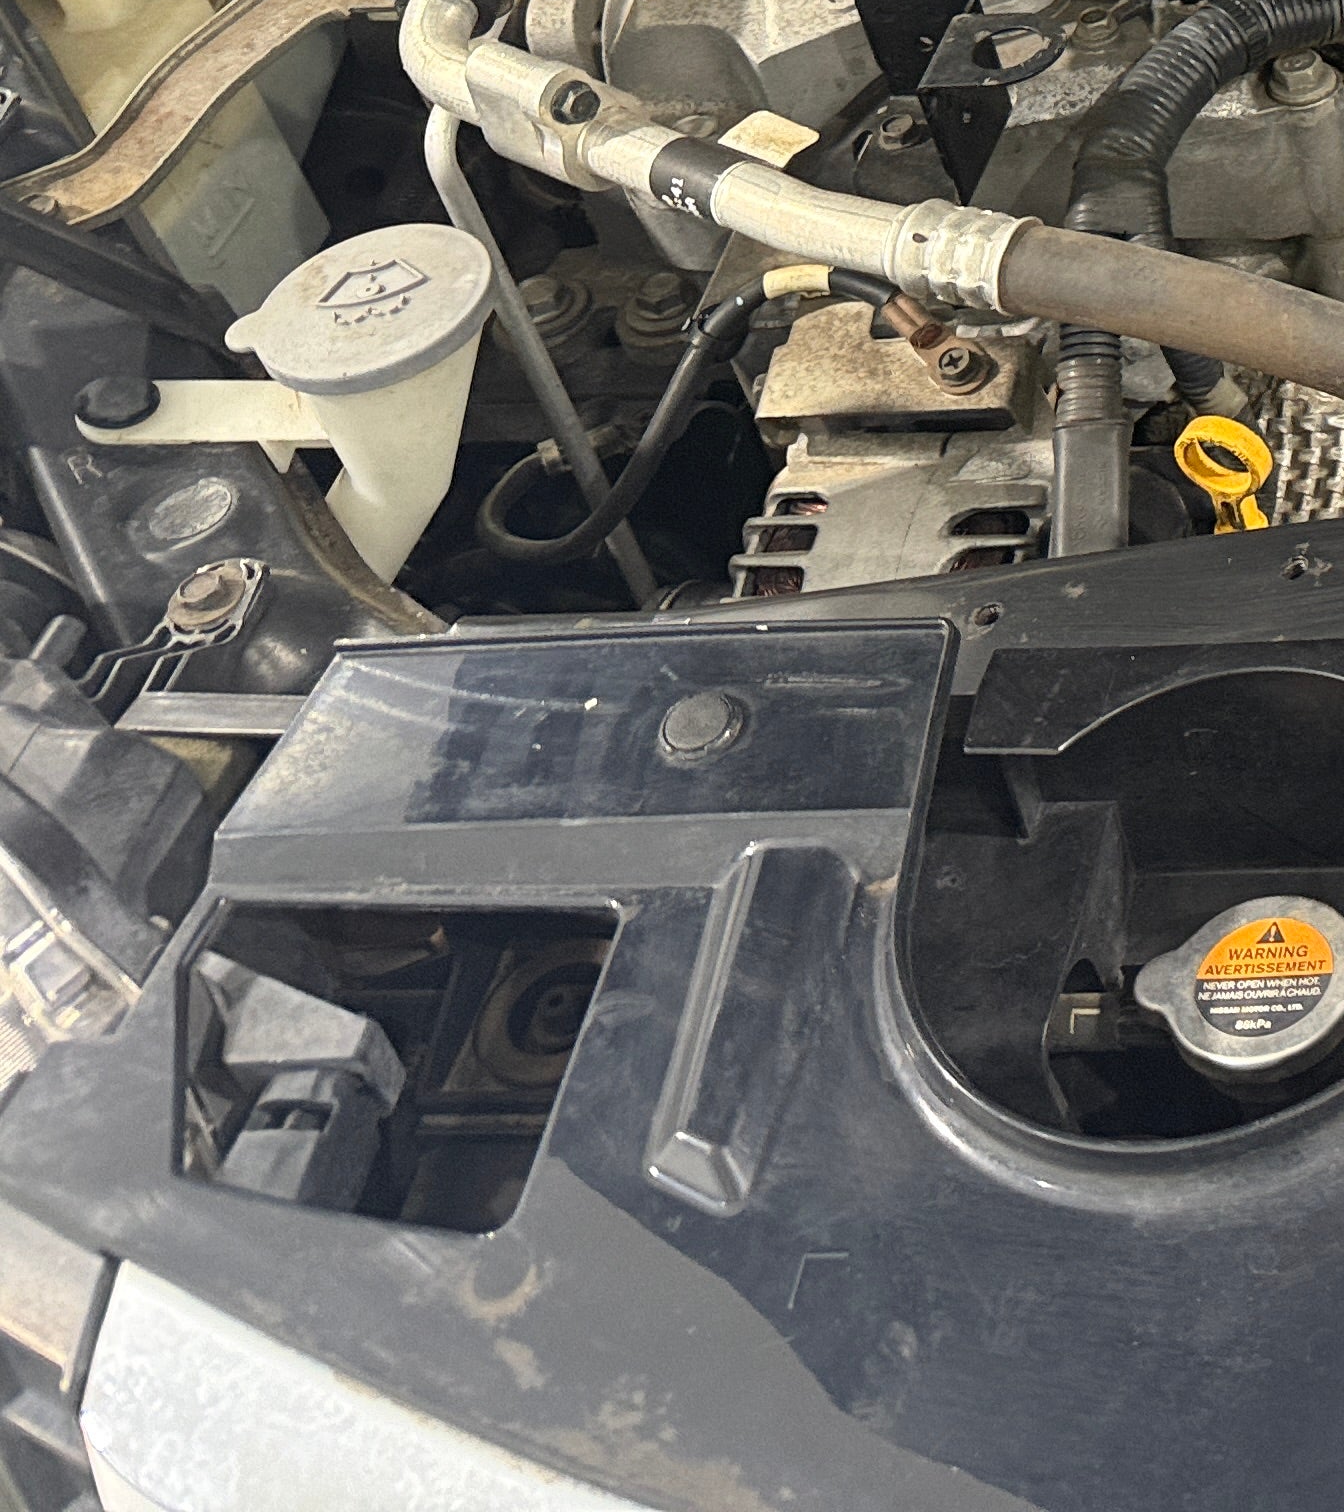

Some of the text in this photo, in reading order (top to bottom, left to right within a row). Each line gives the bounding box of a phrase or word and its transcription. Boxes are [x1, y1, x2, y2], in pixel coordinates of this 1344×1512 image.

[1228, 945, 1309, 960] WARNING
[1204, 960, 1326, 975] AVERTISSEMENT
[1203, 980, 1236, 990] NEVER
[1237, 979, 1265, 989] OPEN
[1266, 978, 1297, 988] WHEN
[1198, 991, 1212, 1000] NE
[1212, 990, 1243, 1000] JAMAIS
[1244, 989, 1279, 999] OUVRIR
[1286, 987, 1321, 997] CHAUD.
[1241, 1005, 1270, 1013] MOTOR
